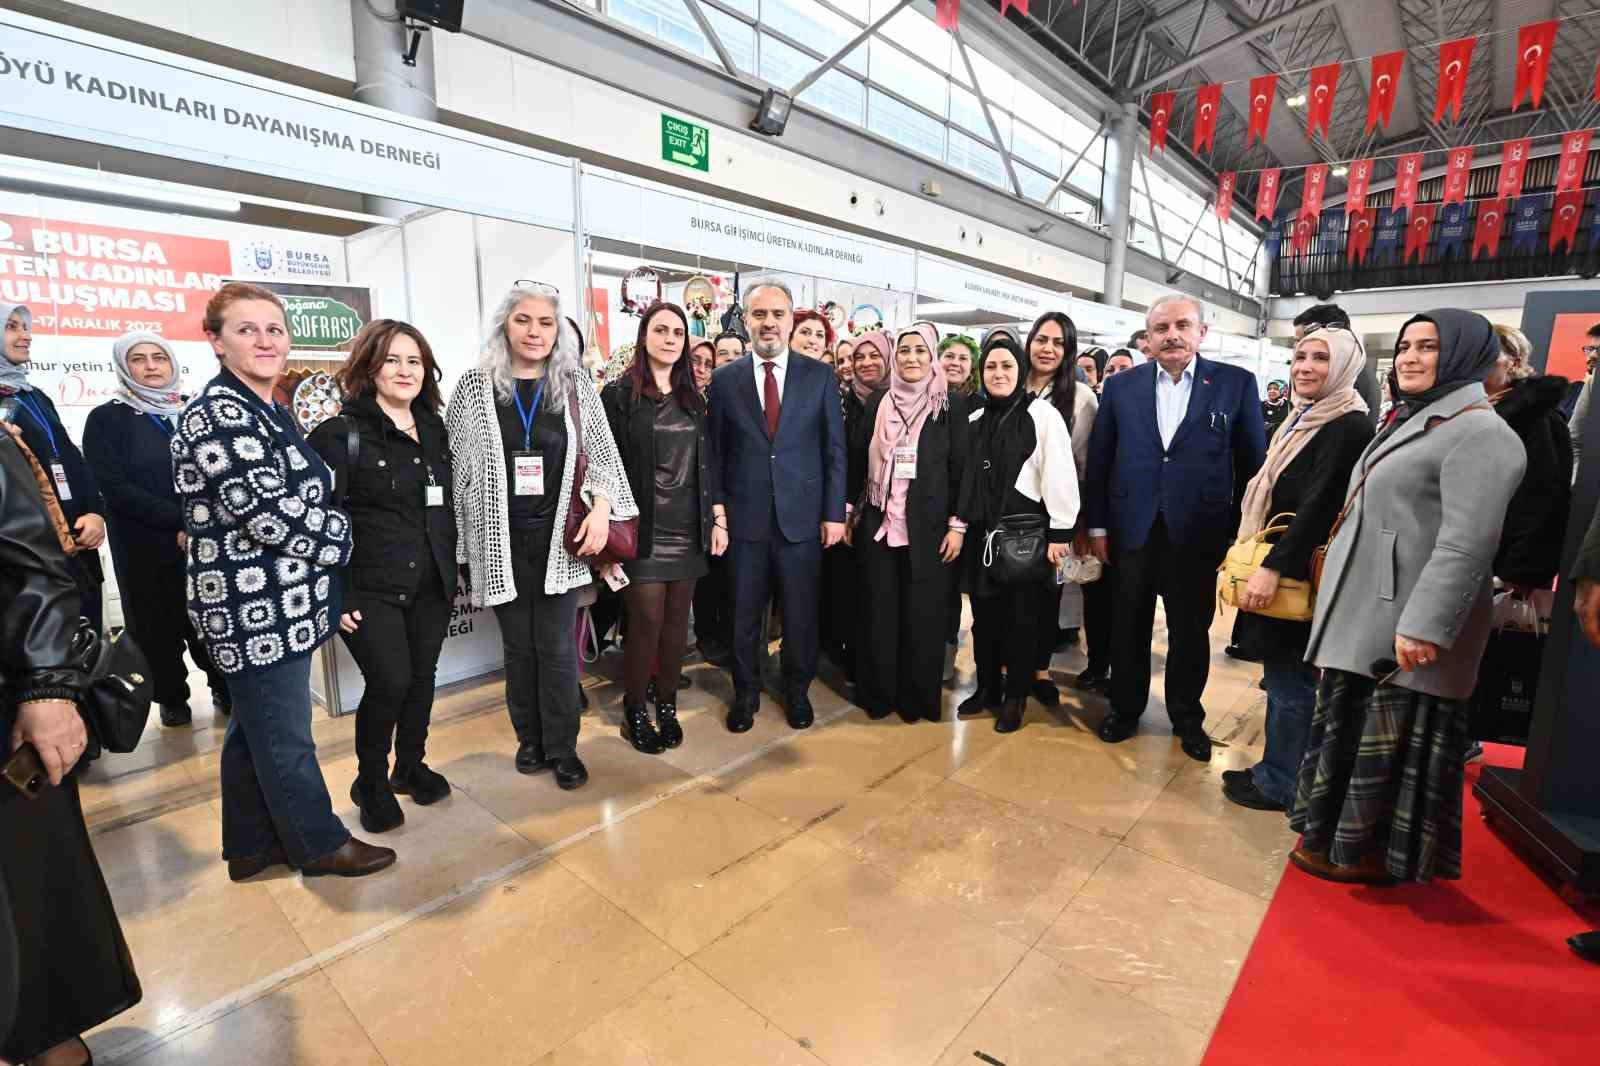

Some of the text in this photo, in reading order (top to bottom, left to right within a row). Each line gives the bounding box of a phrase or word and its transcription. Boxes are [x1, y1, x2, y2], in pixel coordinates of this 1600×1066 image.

[65, 70, 216, 121] KADINLARI
[224, 107, 355, 151] DAYANIŞMA
[360, 138, 441, 170] DERNEĞİ
[666, 120, 689, 136] ÇIKIŞ
[669, 135, 687, 148] EXIT
[690, 216, 721, 233] BURSA
[766, 231, 797, 249] ÜRETEN
[32, 228, 168, 265] BURSA
[287, 250, 329, 263] BURSA
[65, 259, 223, 292] KADINLAR
[0, 278, 187, 313] ULUŞMASI
[60, 317, 121, 331] ARALIK
[125, 320, 163, 334] 2023
[291, 314, 354, 339] SOFRASI
[449, 618, 473, 637] EĞİ
